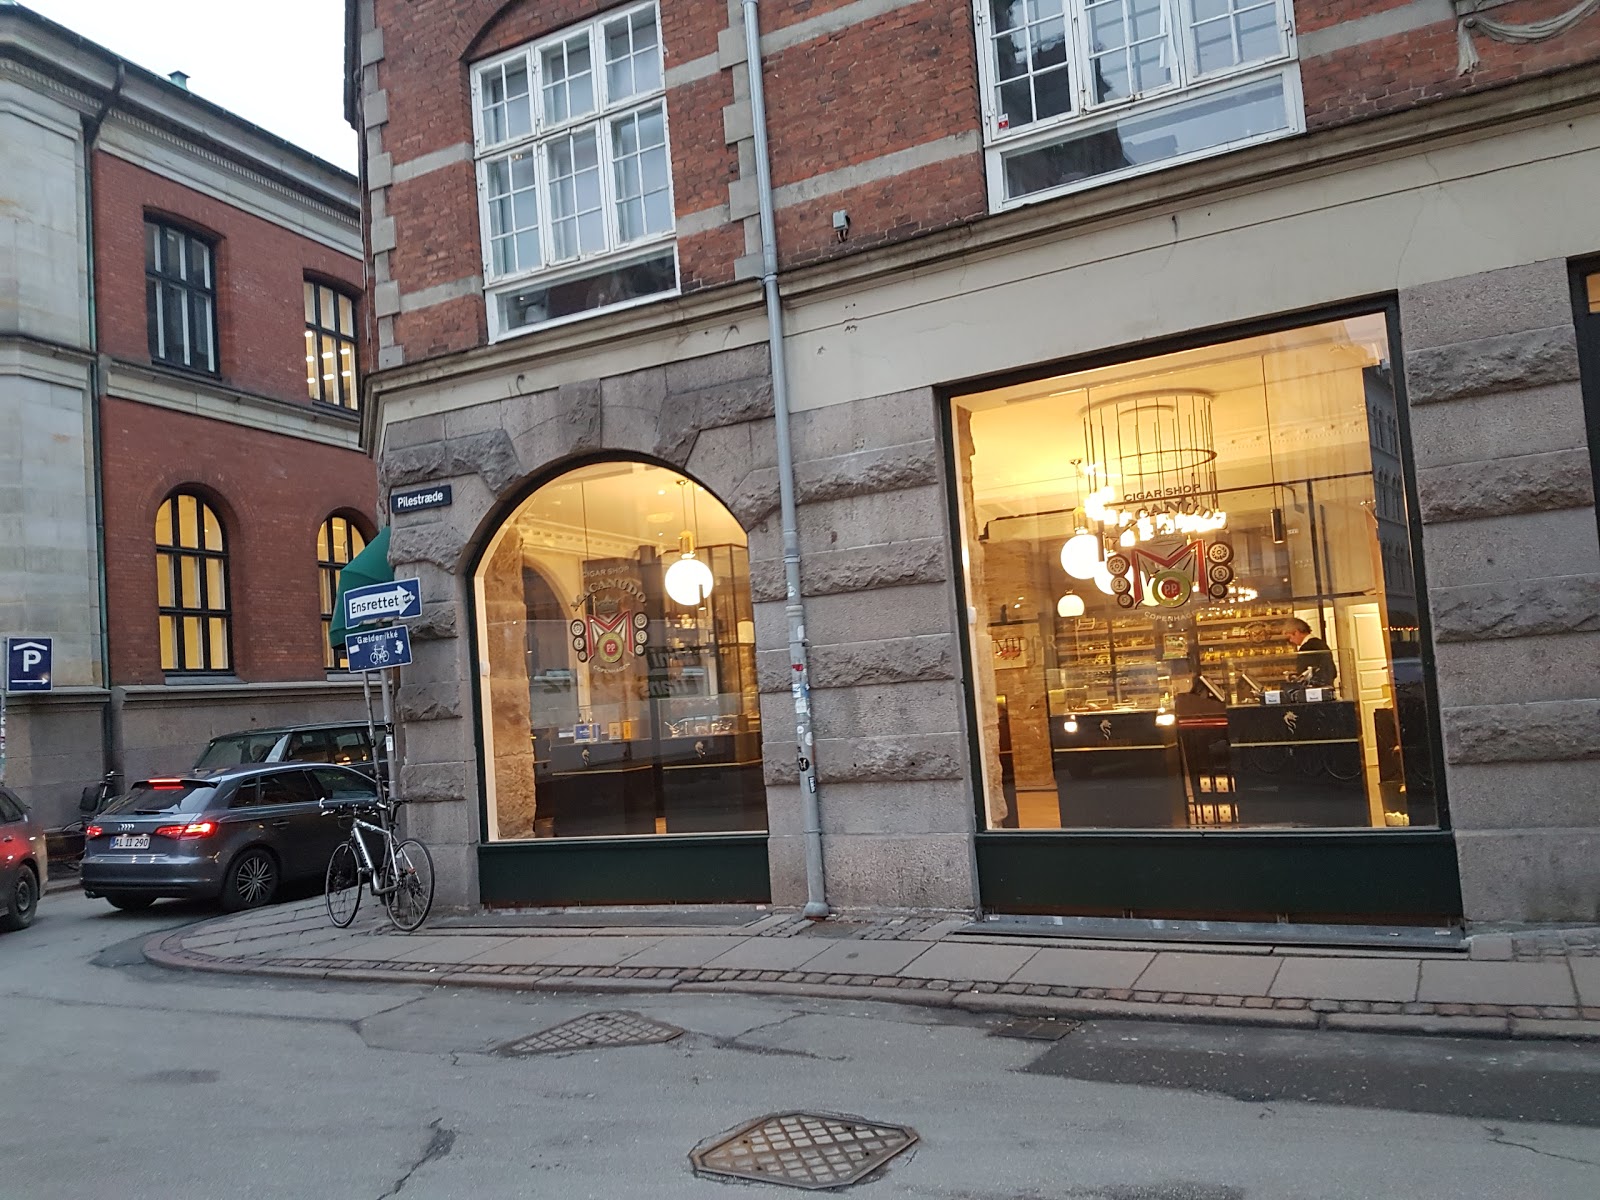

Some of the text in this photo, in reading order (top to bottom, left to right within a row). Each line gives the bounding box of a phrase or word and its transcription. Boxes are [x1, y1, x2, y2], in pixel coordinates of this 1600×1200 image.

[397, 490, 444, 508] Pilestræde
[1124, 483, 1201, 502] CIGAR SHOP
[582, 565, 630, 578] CIGAR SHOP
[351, 594, 400, 614] Ensrettet
[23, 649, 42, 672] P
[134, 838, 149, 847] 290
